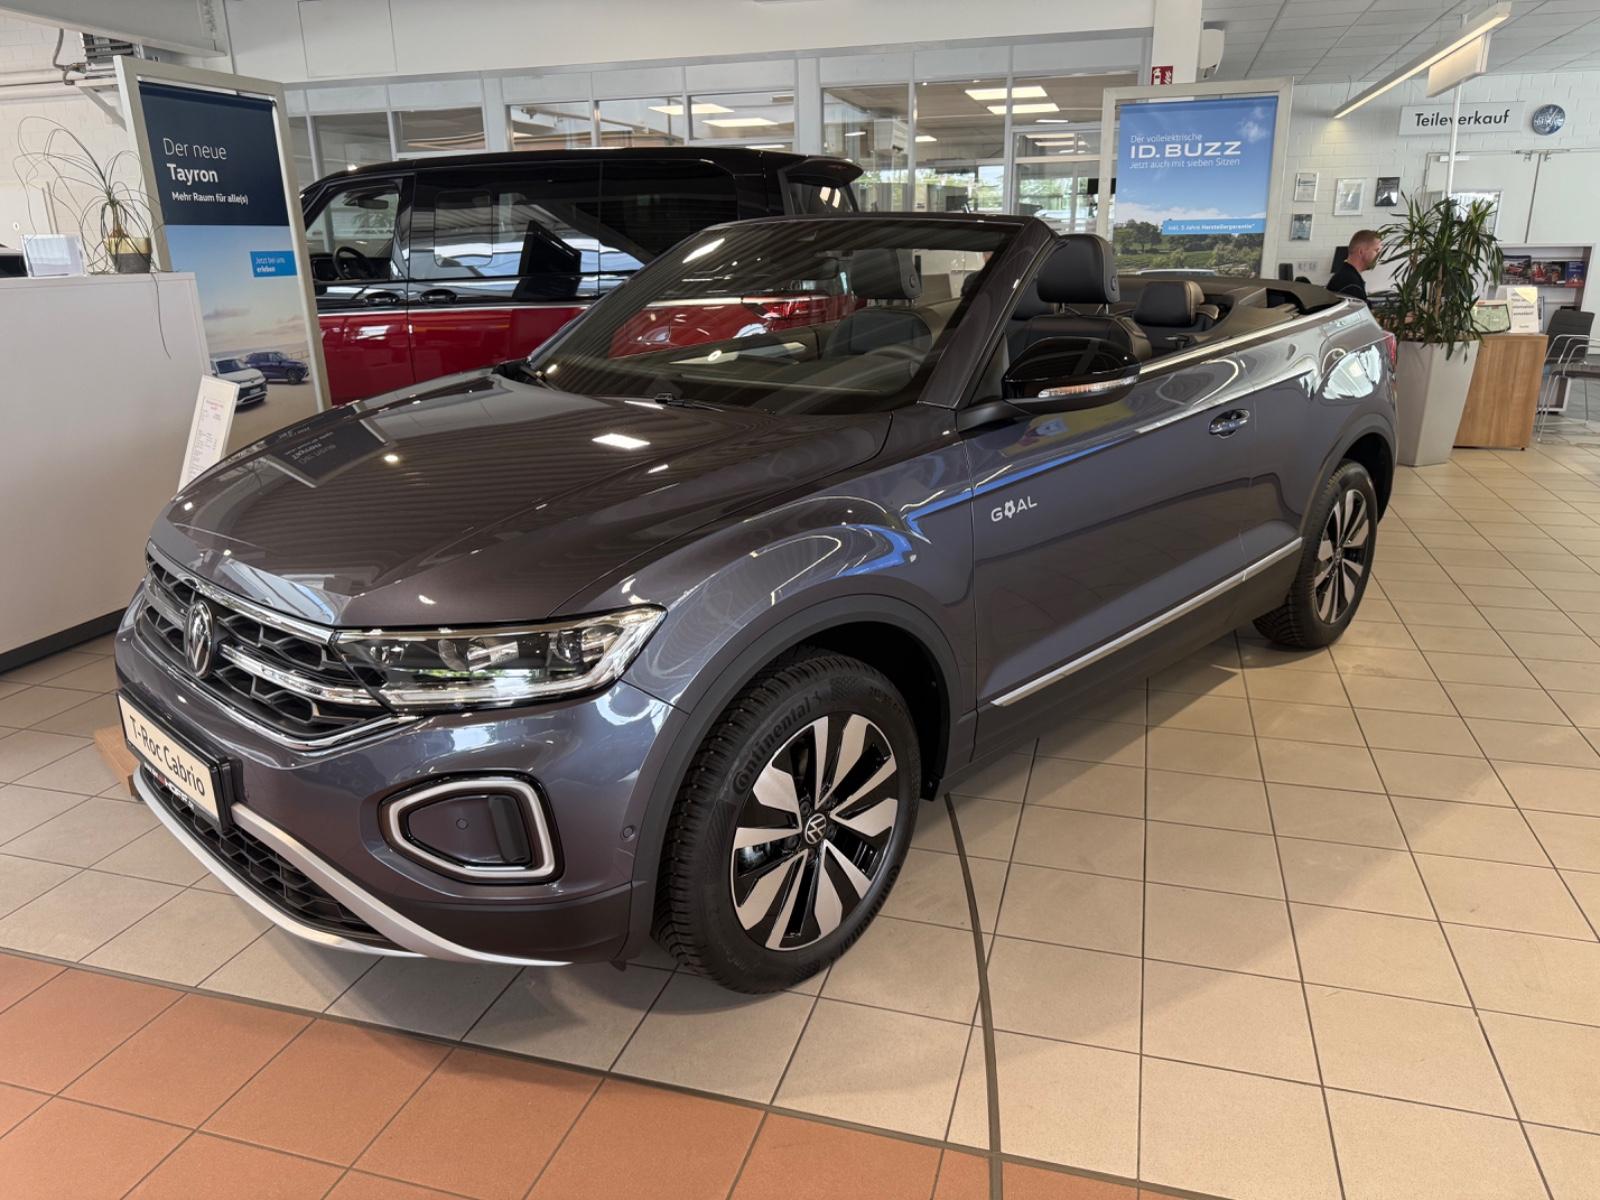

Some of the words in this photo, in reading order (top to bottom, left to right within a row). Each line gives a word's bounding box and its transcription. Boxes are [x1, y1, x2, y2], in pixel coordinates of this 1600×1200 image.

[163, 137, 188, 157] Der
[193, 144, 227, 160] neue
[1130, 135, 1144, 144] Der
[166, 163, 219, 186] Tayron
[1129, 160, 1148, 169] Jetzt
[1150, 159, 1170, 168] auch
[1171, 159, 1185, 168] mit
[1187, 158, 1214, 168] sieben
[1215, 157, 1240, 167] Sitzen
[171, 191, 192, 201] Mehr
[193, 192, 215, 202] Raum
[215, 193, 226, 203] für
[227, 194, 249, 205] alle(s)
[991, 495, 1038, 522] GOAL
[130, 714, 163, 762] T-Roc
[163, 745, 205, 796] Cabrio
[732, 697, 812, 794] Continental
